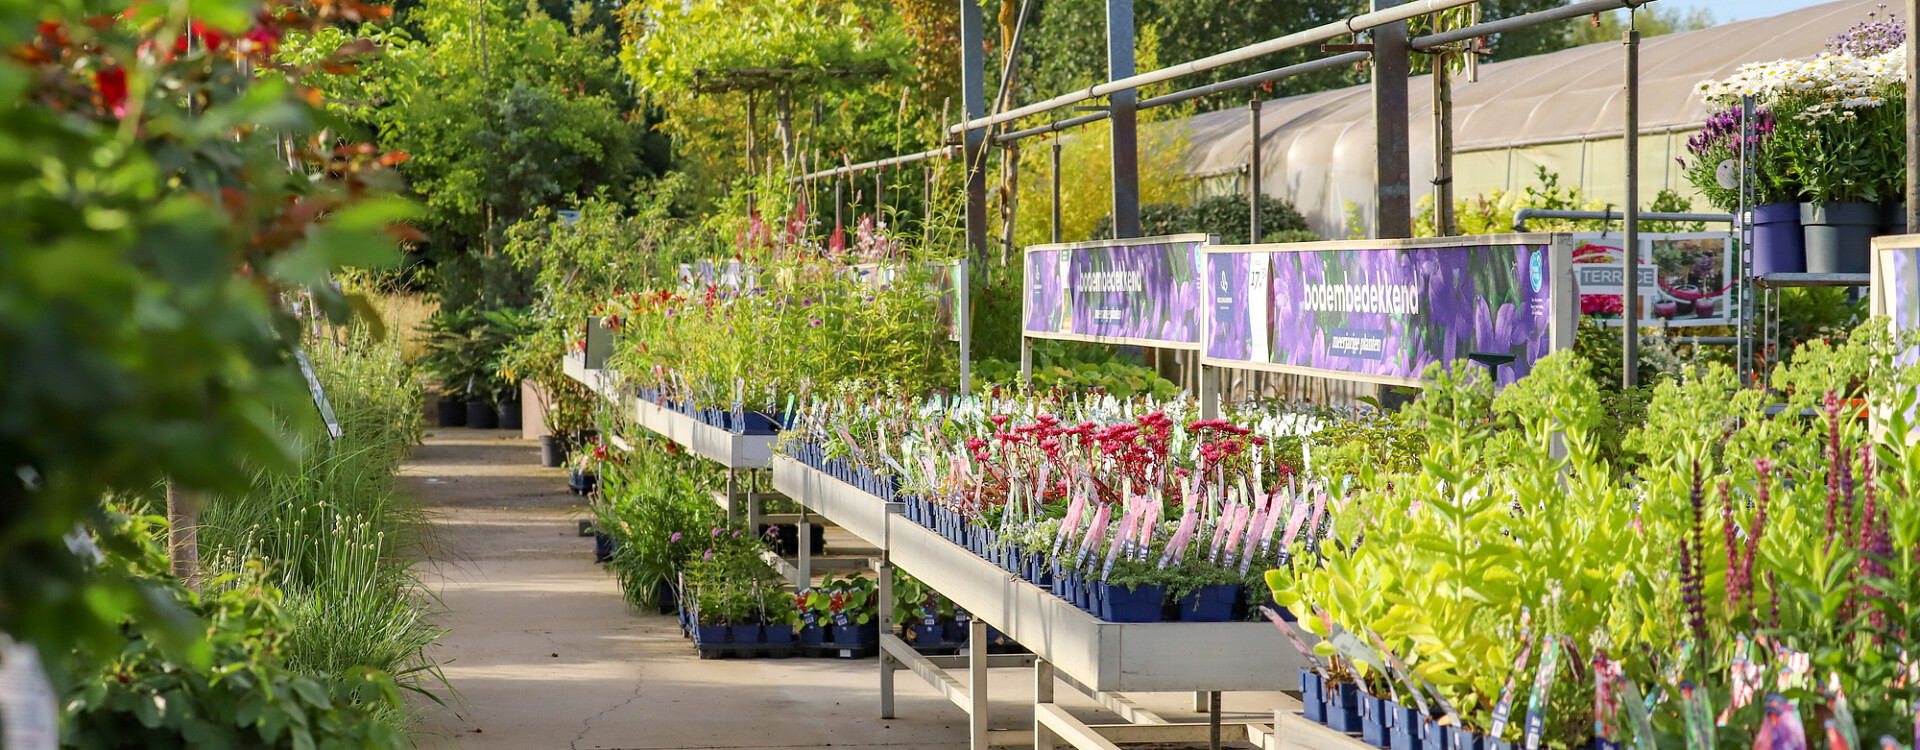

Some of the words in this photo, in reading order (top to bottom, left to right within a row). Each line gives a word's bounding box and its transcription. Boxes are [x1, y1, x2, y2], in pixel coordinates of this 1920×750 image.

[1079, 259, 1142, 292] bodembedekkend
[1583, 270, 1653, 284] TERRCE
[1303, 270, 1419, 315] bodembedekkend
[1332, 332, 1360, 355] meerjarige
[1359, 333, 1381, 355] planten
